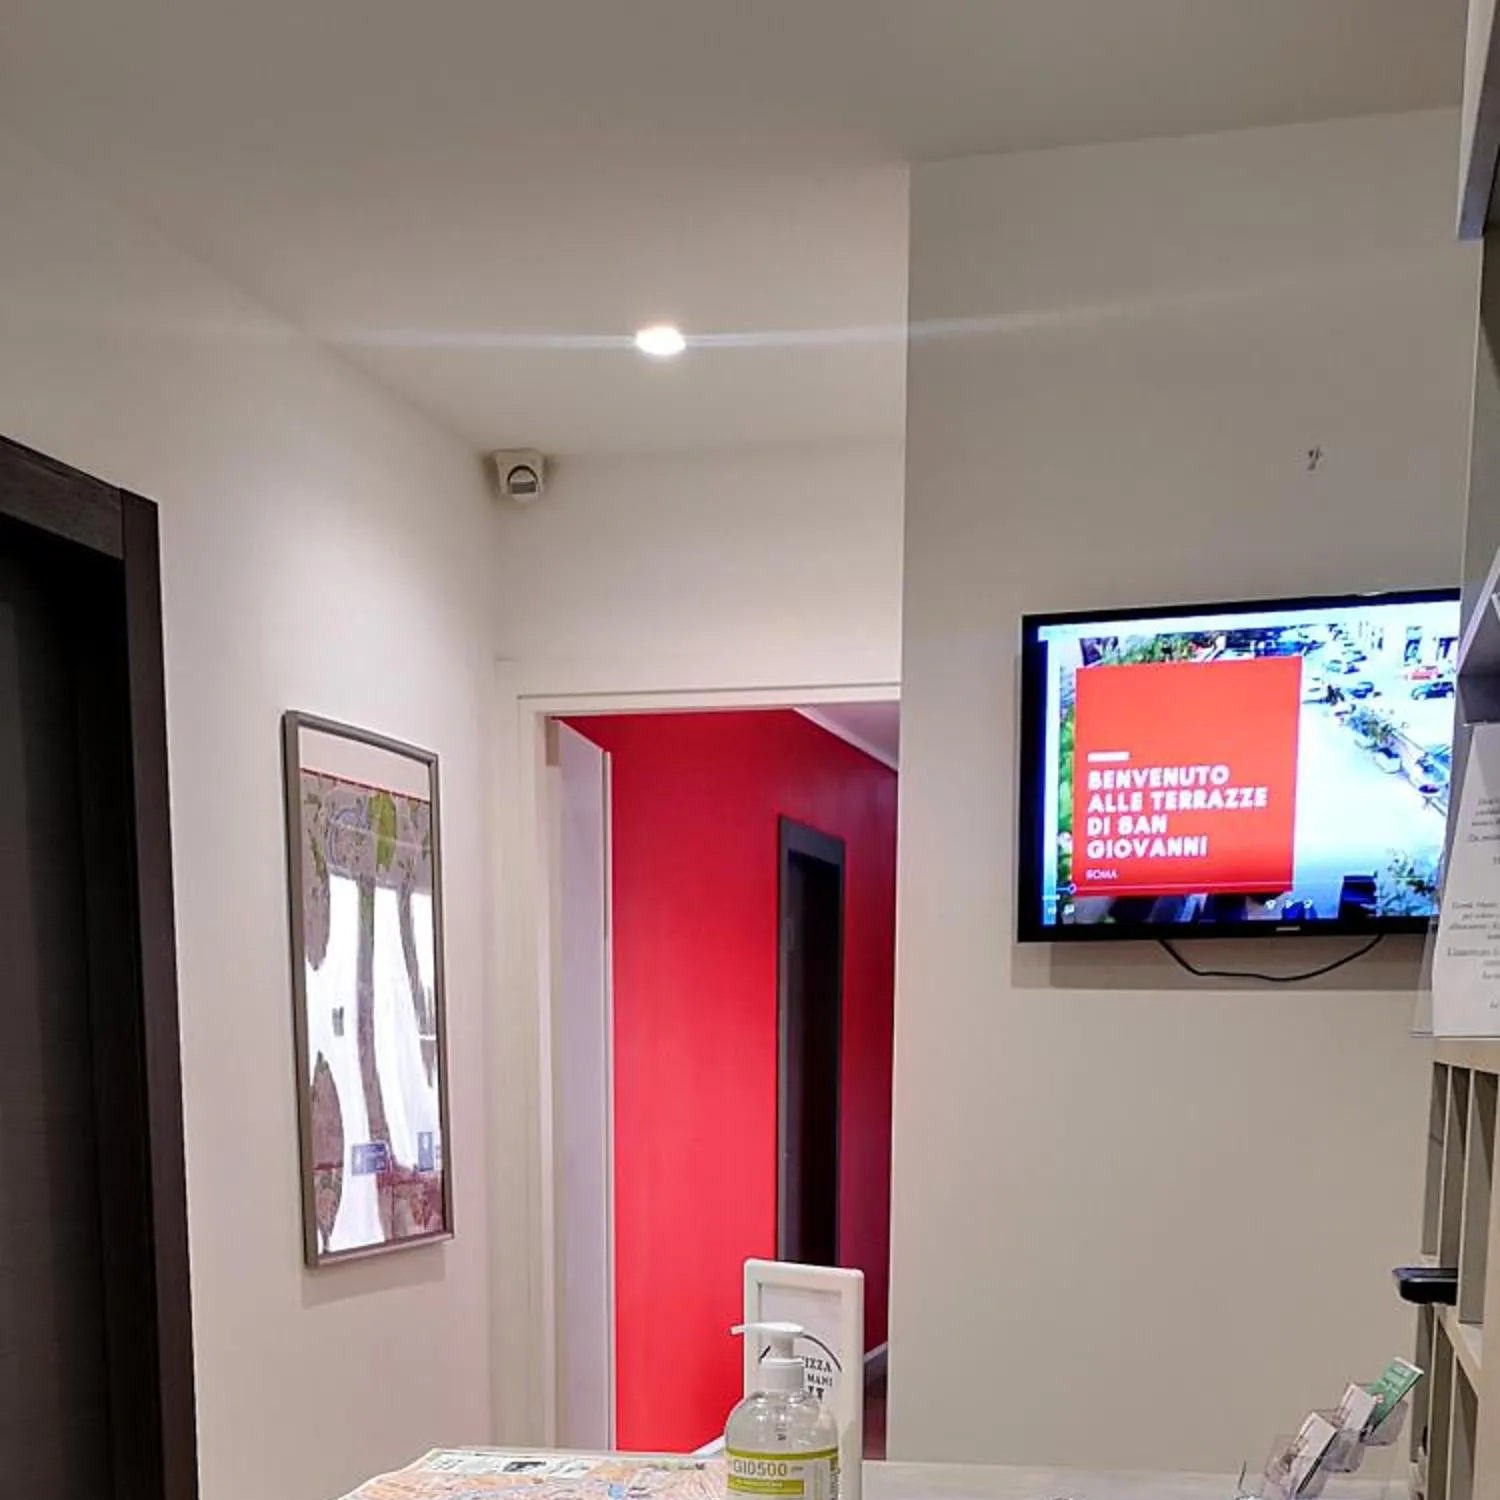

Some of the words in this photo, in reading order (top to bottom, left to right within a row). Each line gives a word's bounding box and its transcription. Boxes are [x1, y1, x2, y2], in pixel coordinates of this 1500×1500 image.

[1087, 764, 1230, 790] BENVENUTO
[1087, 791, 1143, 813] ALLE
[1150, 786, 1268, 811] TERRAZZE
[1086, 816, 1111, 837] DI
[1117, 813, 1168, 836] SAN
[1086, 835, 1209, 860] GIOVANNI
